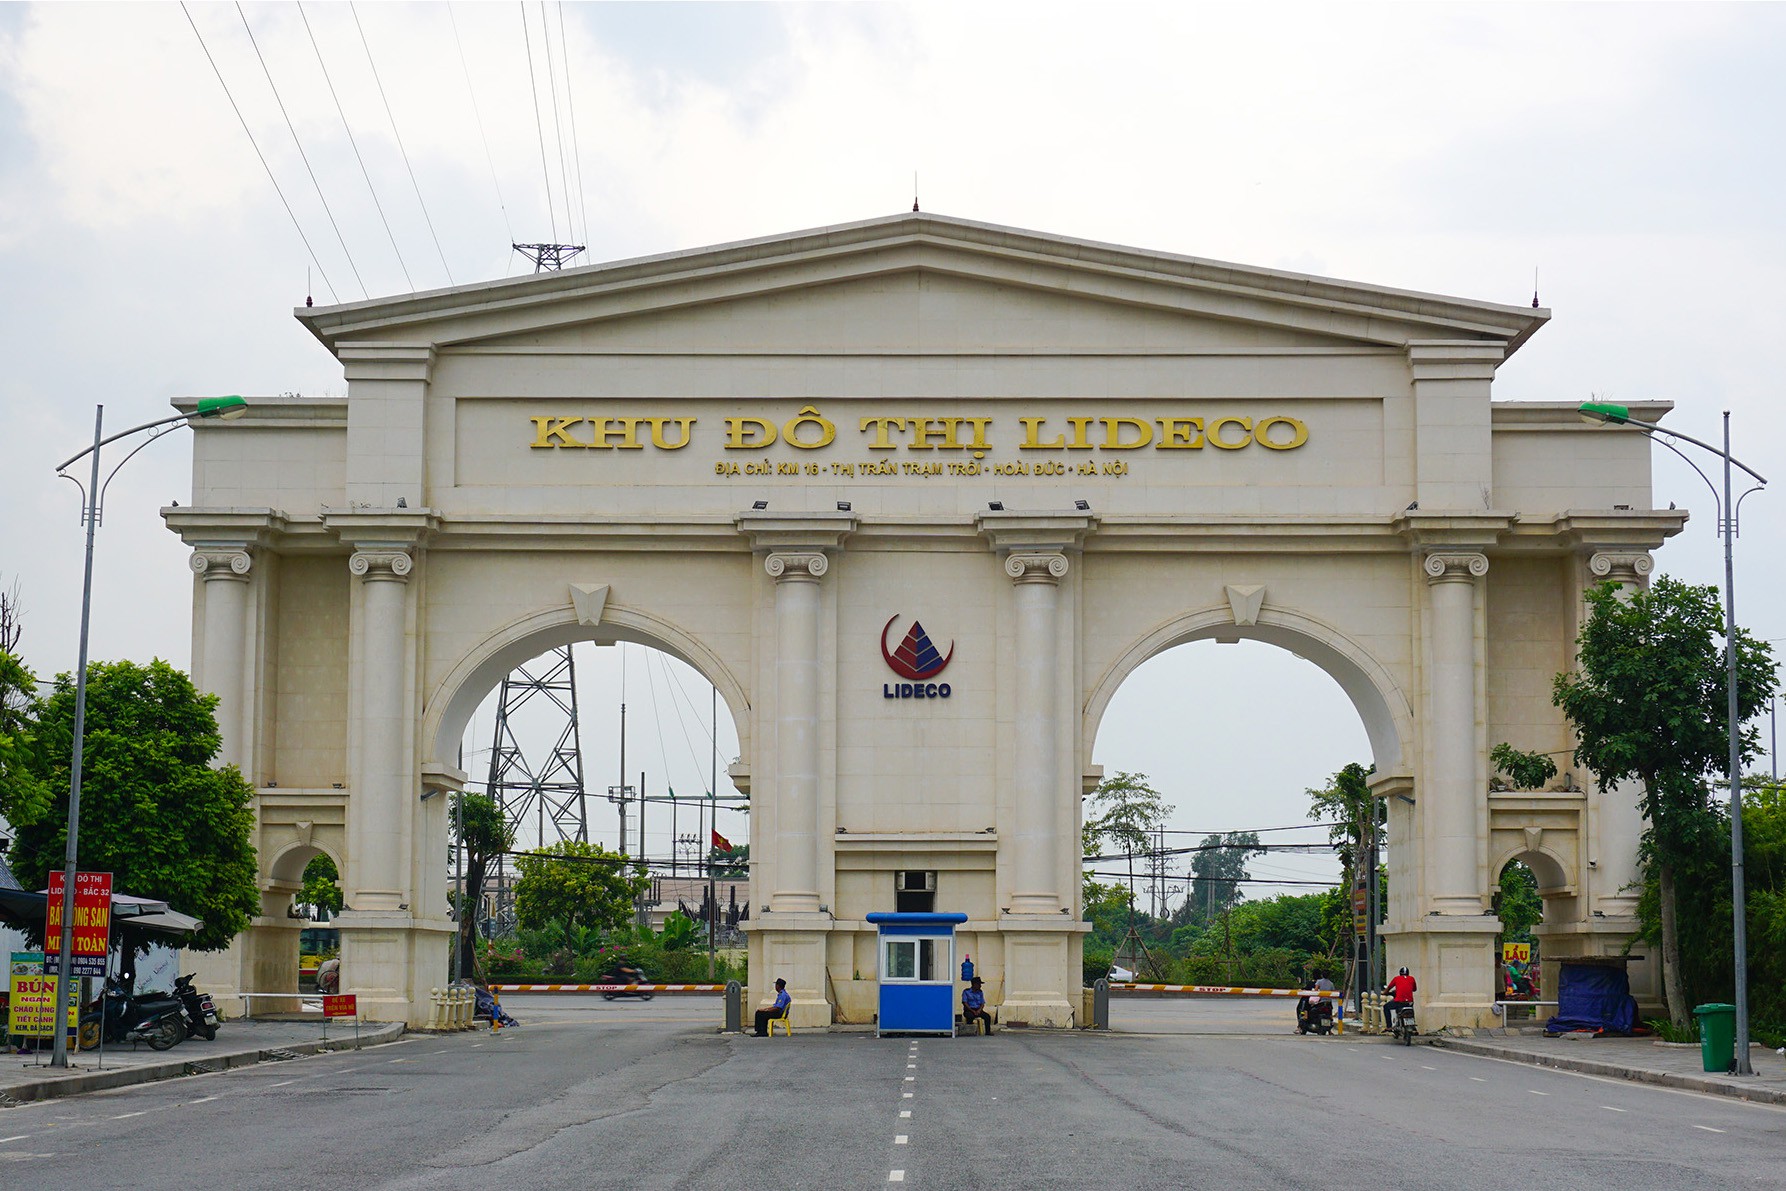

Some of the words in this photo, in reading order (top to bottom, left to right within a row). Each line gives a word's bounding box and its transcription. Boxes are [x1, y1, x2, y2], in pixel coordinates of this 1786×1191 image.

[530, 416, 697, 450] KHU
[724, 405, 836, 450] ĐÔ
[859, 416, 993, 459] THỊ
[1019, 416, 1309, 450] LIDECO
[715, 461, 741, 478] ĐỊA
[744, 458, 772, 475] CHỈ:
[777, 462, 799, 475] KM
[804, 462, 819, 475] 16
[831, 462, 855, 478] THỊ
[859, 458, 898, 475] TRẤN
[902, 462, 943, 478] TRẠM
[948, 460, 981, 475] TRÔI
[994, 460, 1029, 475] HOÀI
[1033, 460, 1065, 475] ĐỨC
[1077, 460, 1098, 475] HÀ
[1102, 460, 1129, 478] NỘI
[883, 683, 952, 699] LIDECO
[91, 875, 102, 885] THỊ
[83, 884, 99, 896] BẮC
[100, 888, 110, 896] 32
[91, 899, 108, 927] SẢN
[77, 933, 106, 952] TOÀN
[1505, 944, 1528, 961] LẨU
[17, 978, 55, 993] BÚN
